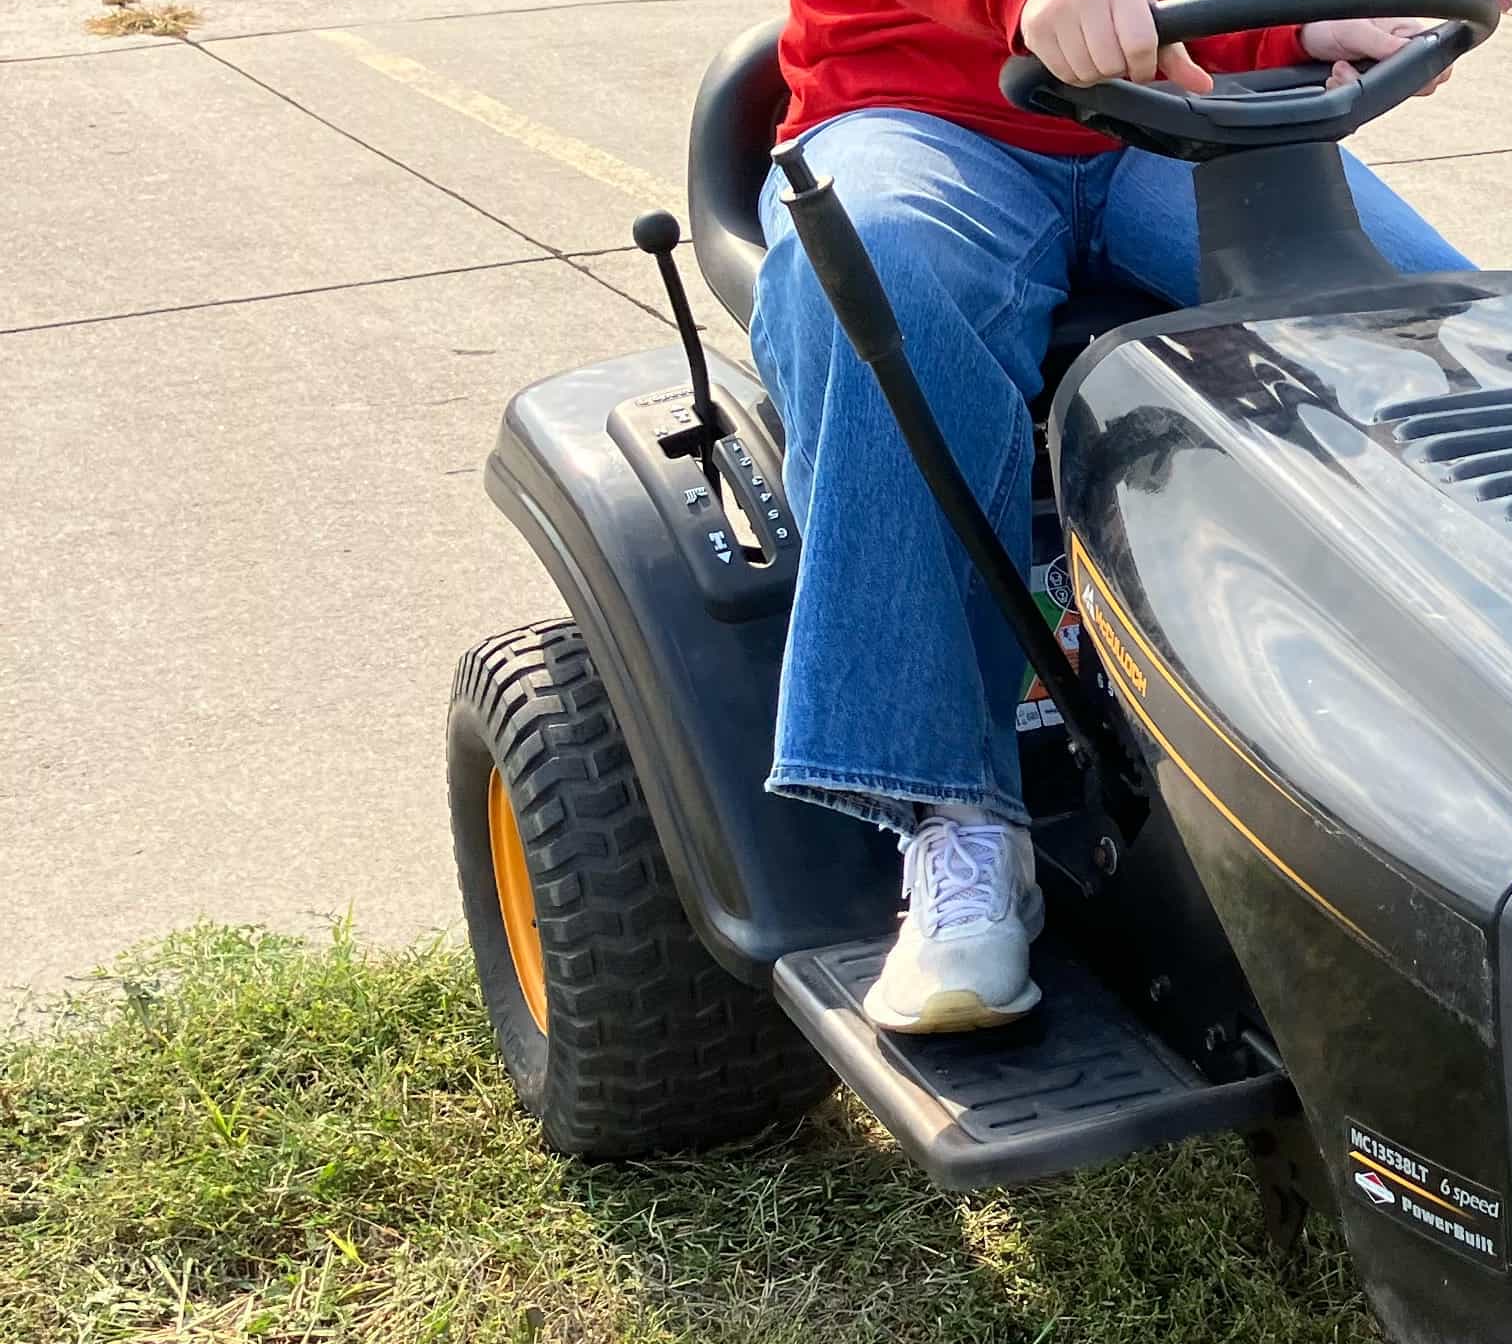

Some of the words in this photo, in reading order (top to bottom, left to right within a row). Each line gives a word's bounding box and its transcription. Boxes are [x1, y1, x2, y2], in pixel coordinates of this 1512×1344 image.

[1350, 1127, 1430, 1184] MC13538LT
[1439, 1178, 1451, 1196] 6
[1453, 1186, 1501, 1219] speed
[1401, 1195, 1499, 1257] PowerBuilt
